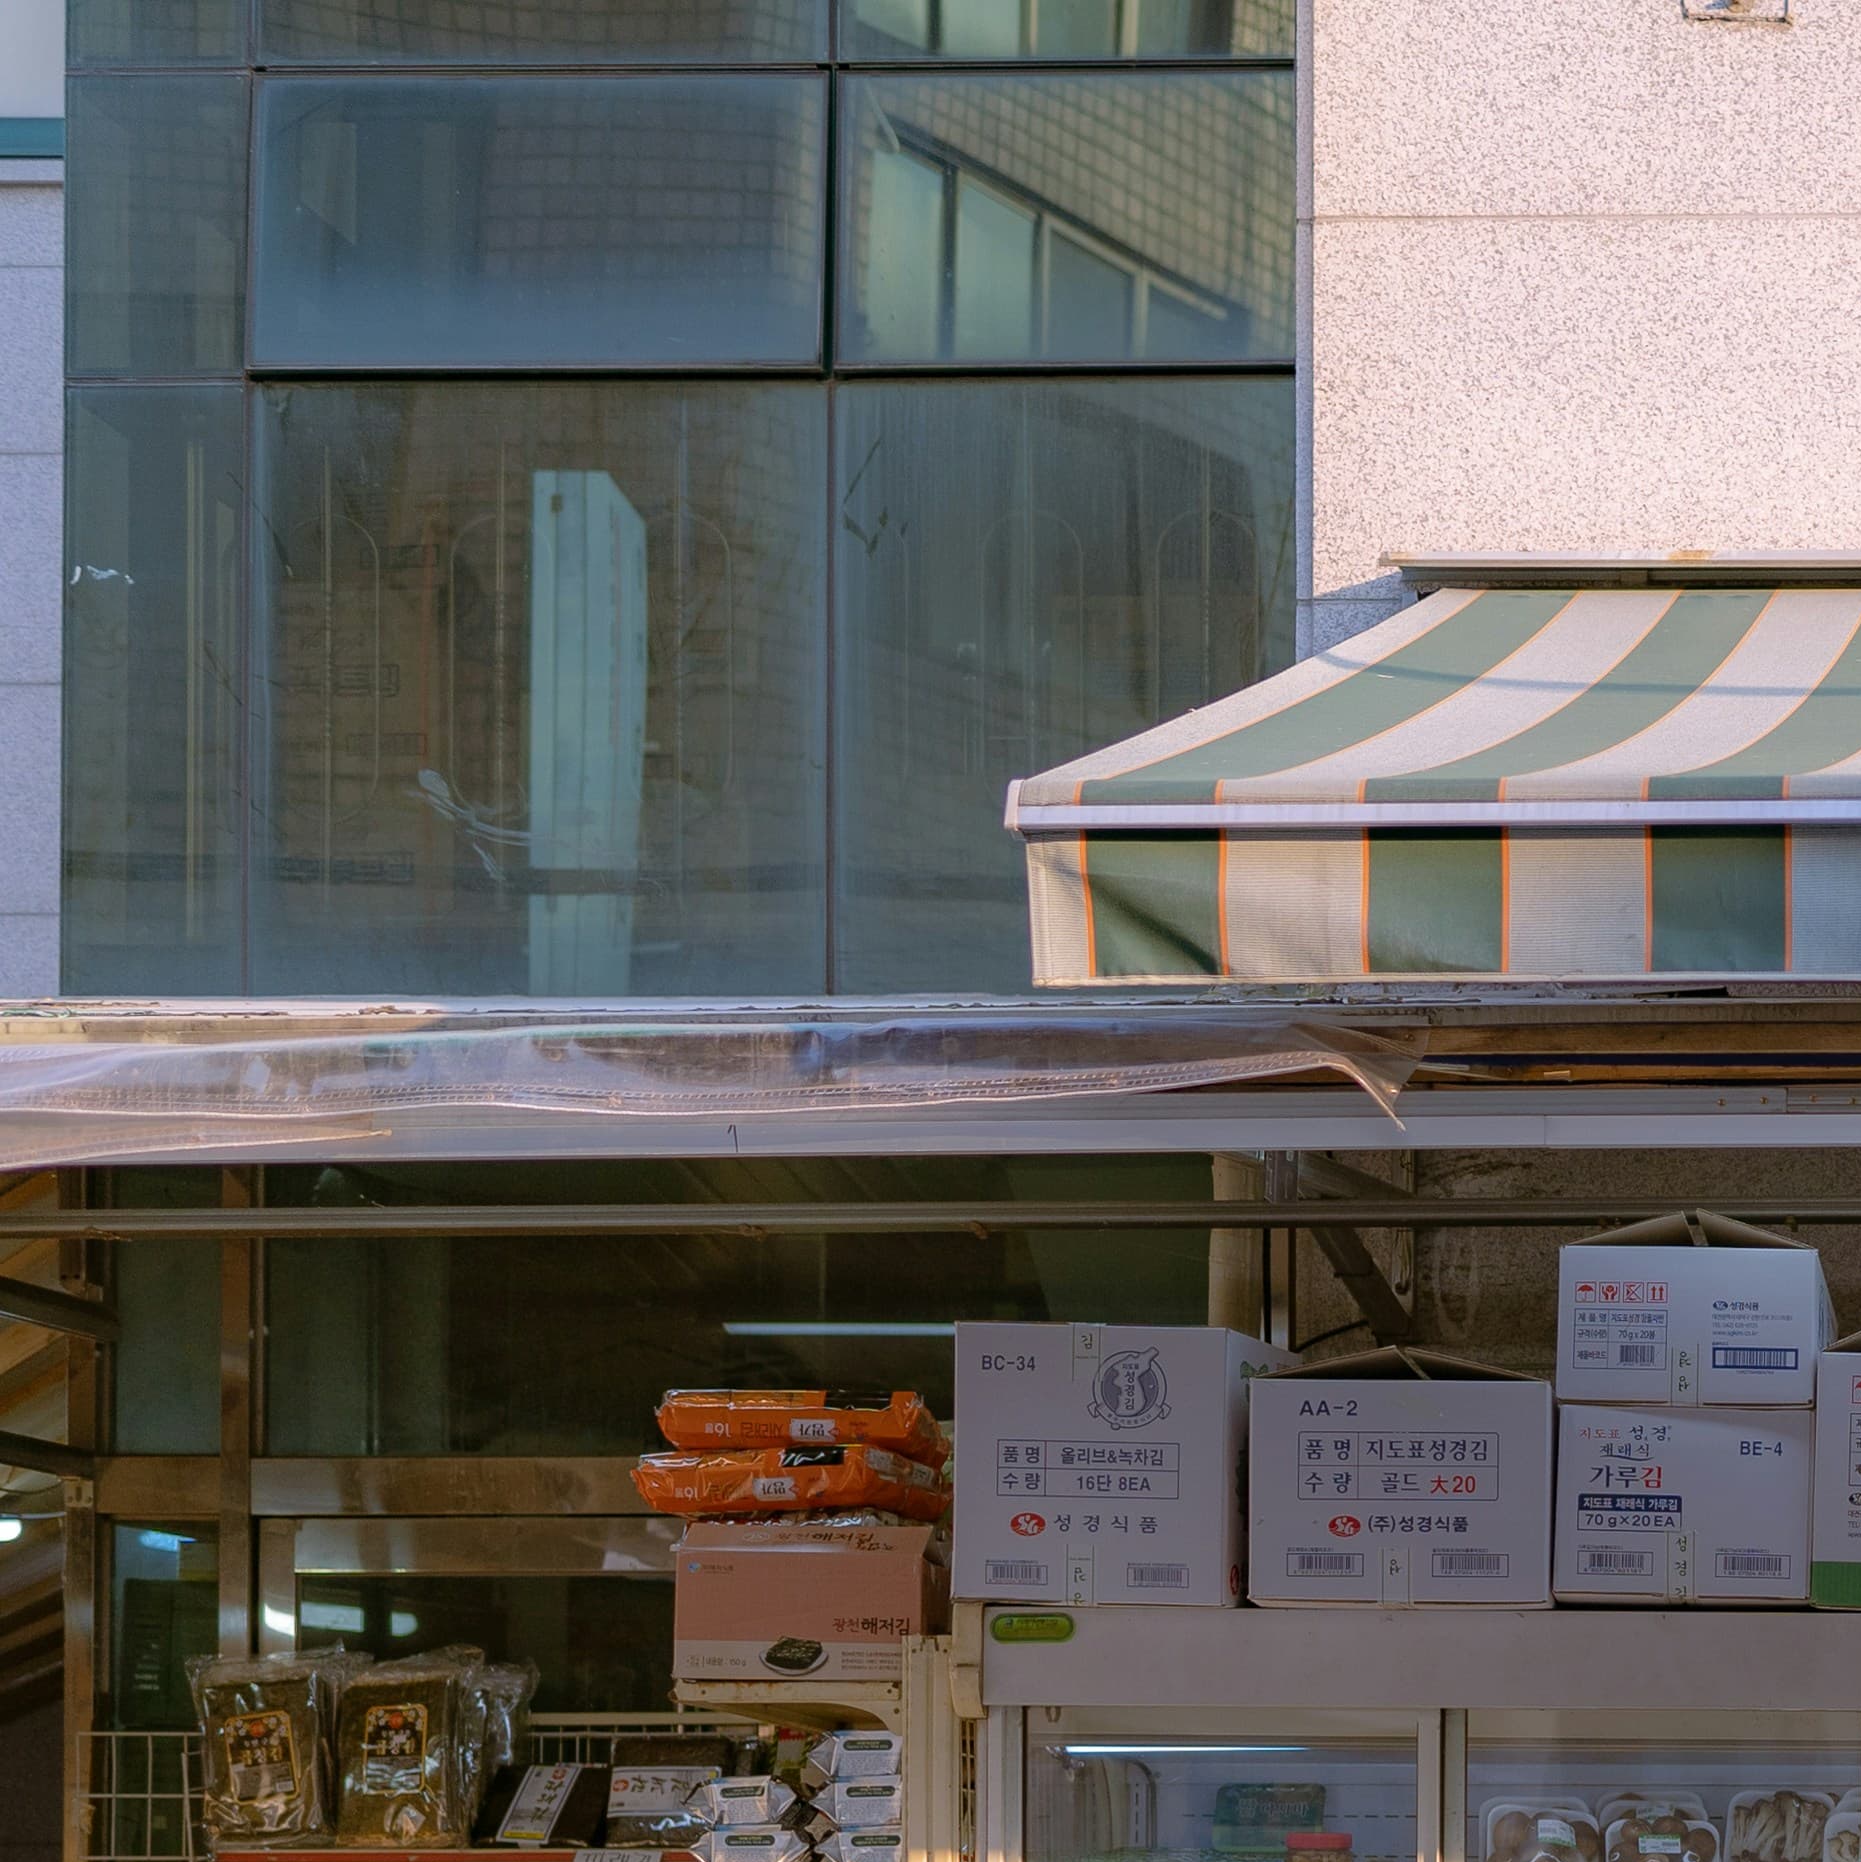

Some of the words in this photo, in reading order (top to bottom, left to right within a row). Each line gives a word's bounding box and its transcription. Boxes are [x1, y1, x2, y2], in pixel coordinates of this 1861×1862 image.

[981, 1355, 1036, 1372] BC-34
[1299, 1400, 1359, 1417] AA-2
[1579, 1427, 1622, 1441] 지도표
[1366, 1439, 1489, 1462] 지도표성경김
[1599, 1443, 1651, 1458] 재래식
[1739, 1441, 1785, 1456] BE-4
[1061, 1447, 1164, 1468] 올리브&녹차김
[1077, 1475, 1112, 1492] 16단
[1118, 1477, 1151, 1492] 8EA
[1381, 1473, 1422, 1494] 골드
[1589, 1465, 1663, 1489] 가루김
[1648, 1499, 1678, 1511] 가루김
[1368, 1515, 1469, 1535] (주)성경식품
